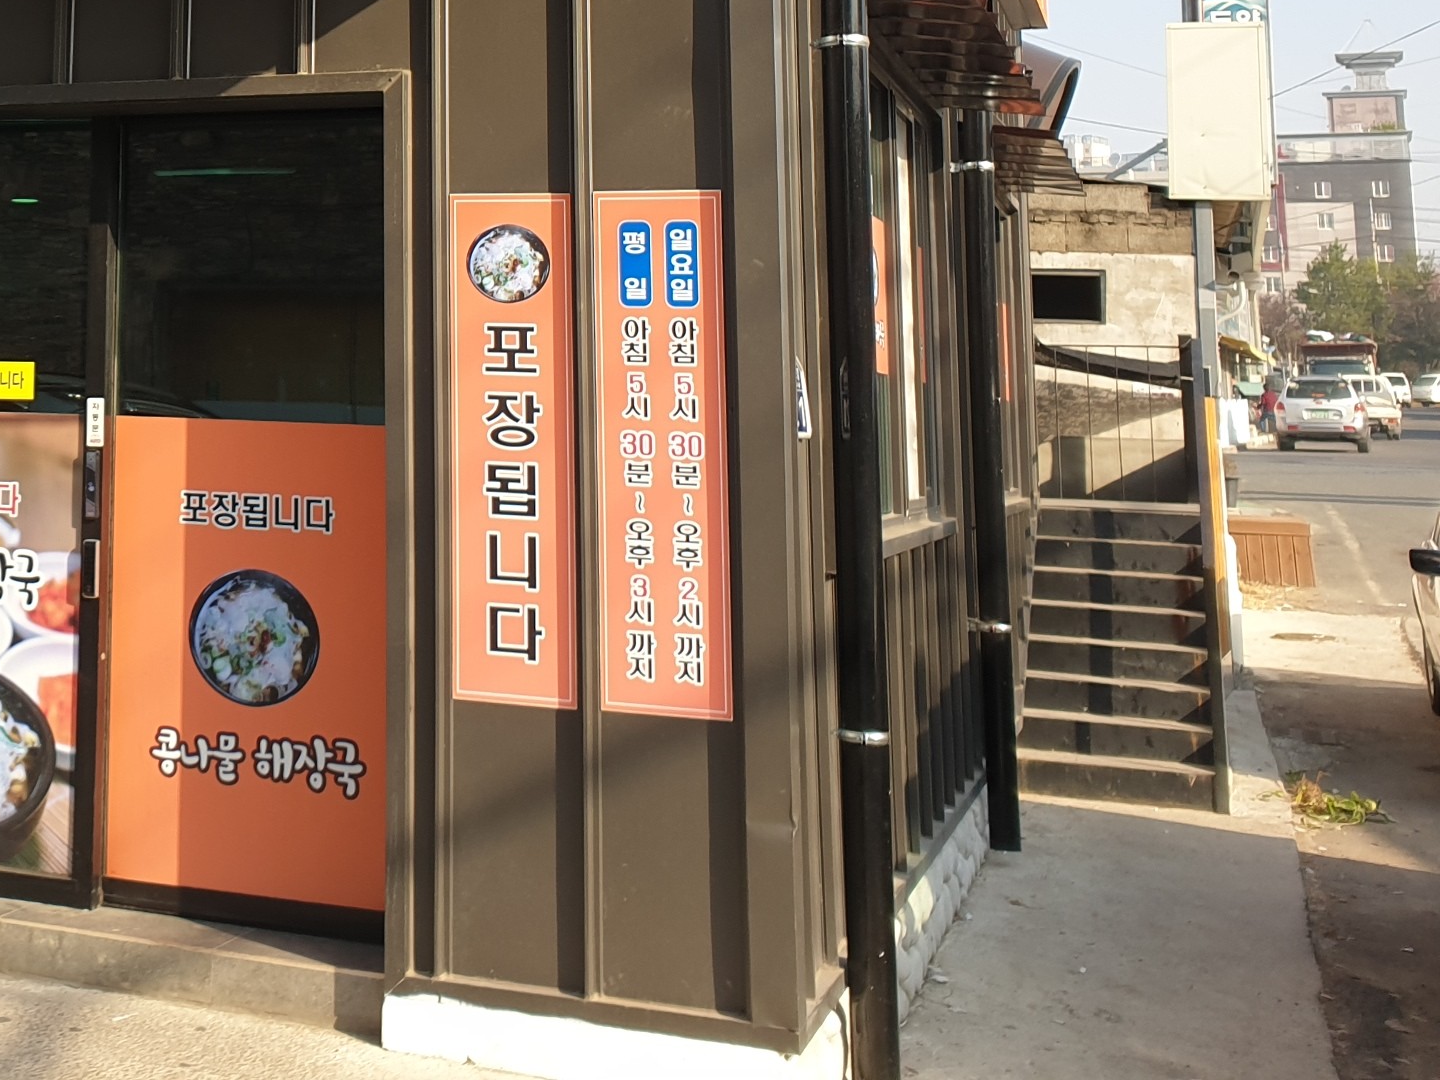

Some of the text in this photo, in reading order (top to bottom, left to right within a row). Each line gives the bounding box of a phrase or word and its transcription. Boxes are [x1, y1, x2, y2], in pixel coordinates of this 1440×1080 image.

[622, 230, 648, 301] 평일
[668, 227, 695, 302] 일요일
[622, 318, 650, 364] 아침
[669, 319, 698, 365] 아침
[624, 373, 650, 419] 5시
[671, 374, 698, 420] 5시
[621, 432, 654, 486] 30분
[670, 433, 703, 487] 30분
[180, 491, 334, 533] 포장됩니다
[482, 323, 544, 664] 포장됩니다
[627, 576, 653, 623] 3시
[675, 579, 702, 627] 2시
[628, 632, 655, 680] 까지
[676, 635, 704, 684] 까지
[150, 727, 366, 799] 콩나물 해장국
